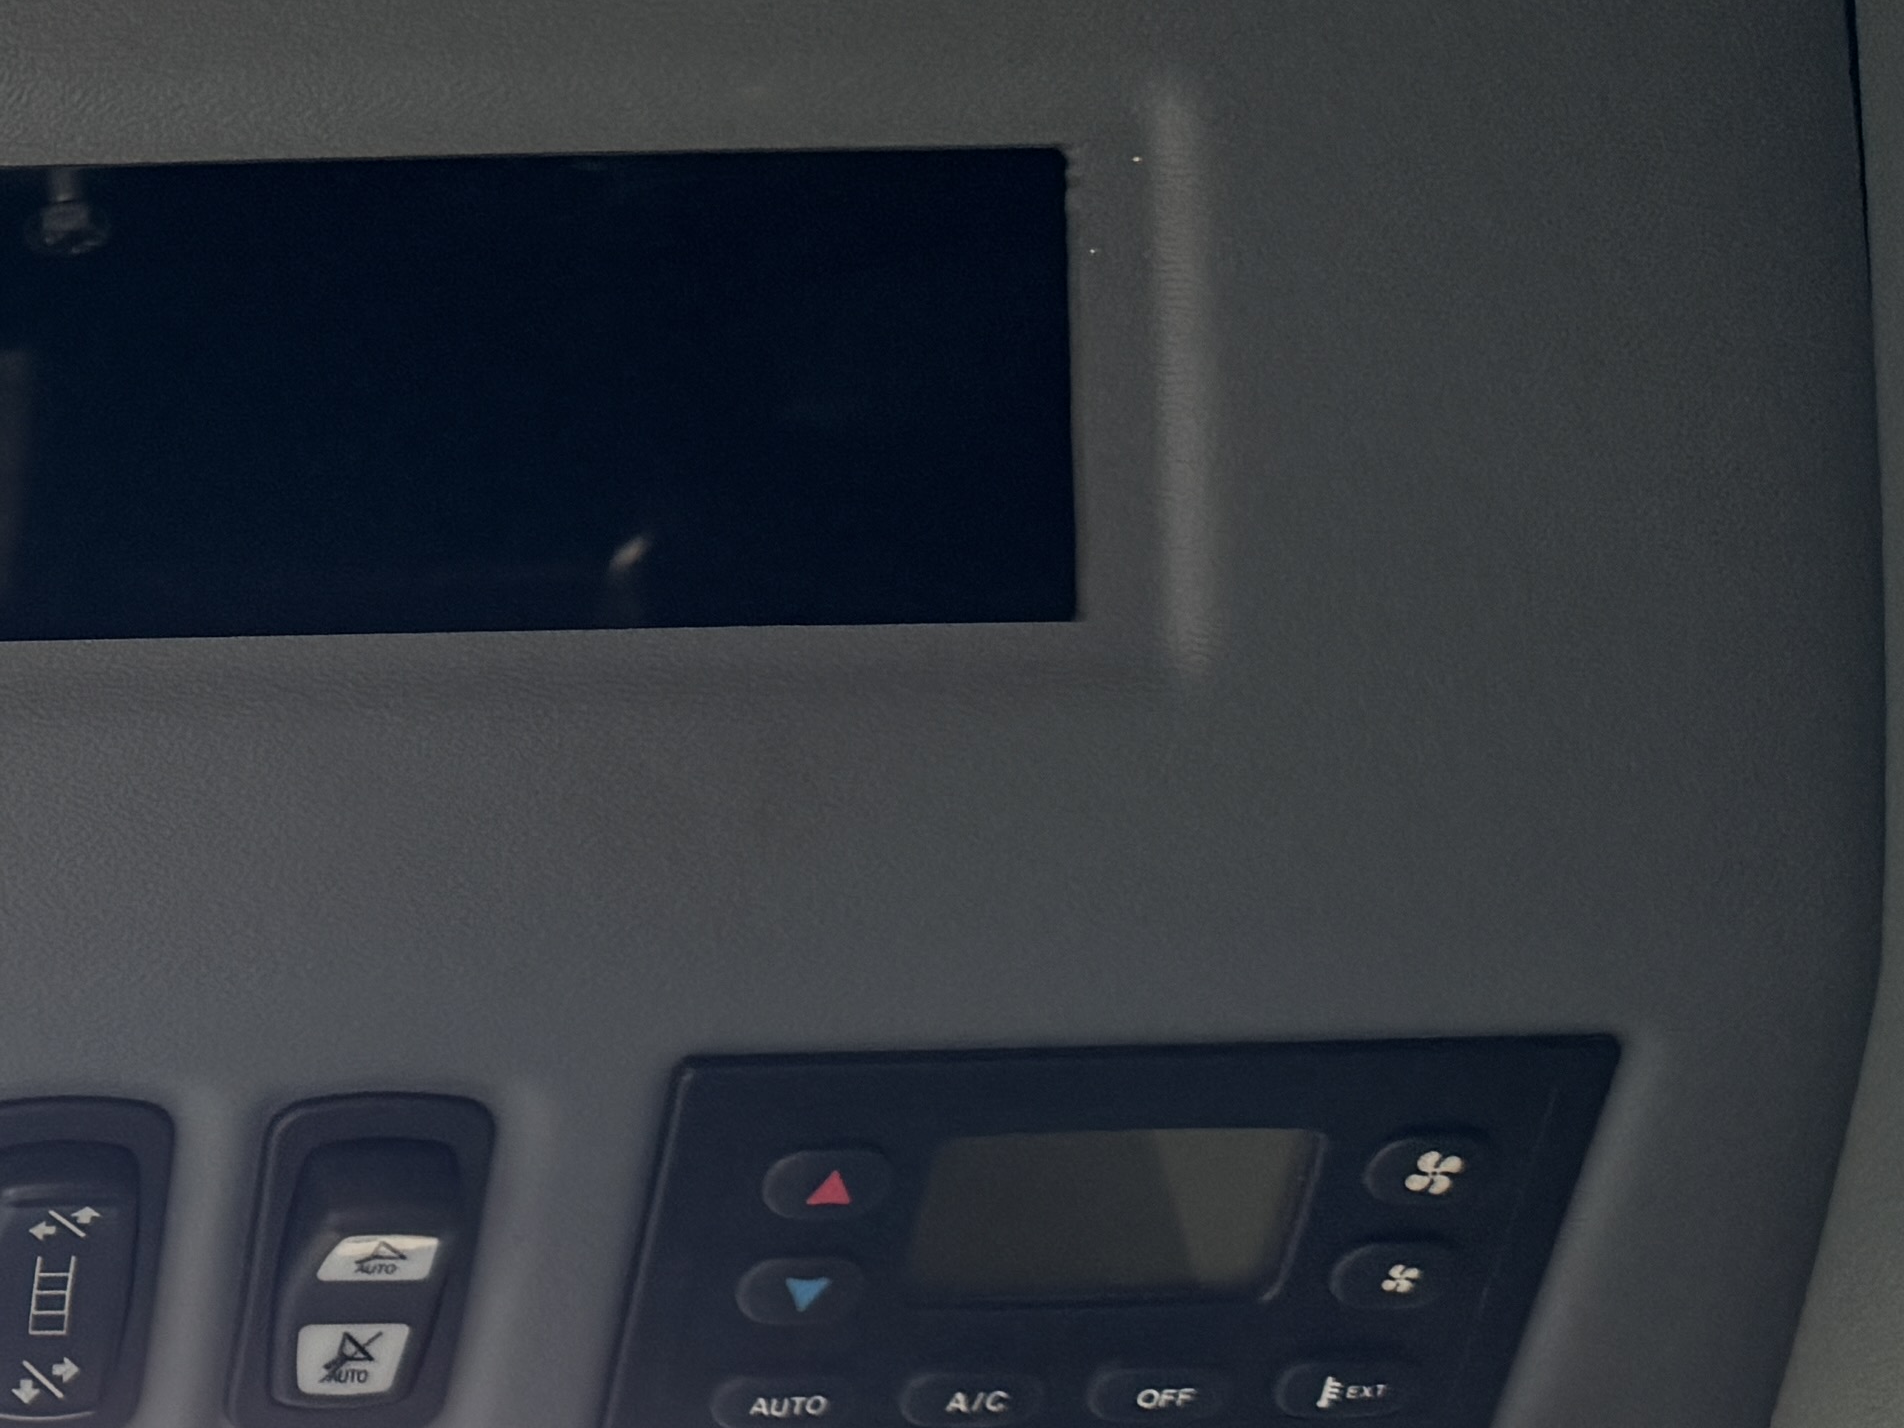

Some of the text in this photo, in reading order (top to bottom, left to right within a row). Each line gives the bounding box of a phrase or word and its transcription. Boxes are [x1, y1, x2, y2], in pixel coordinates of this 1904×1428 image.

[355, 1263, 398, 1275] AUTO
[945, 1390, 1009, 1414] A/C
[1136, 1387, 1197, 1409] OFF
[1345, 1384, 1388, 1400] EXT
[749, 1395, 828, 1419] AUTO
